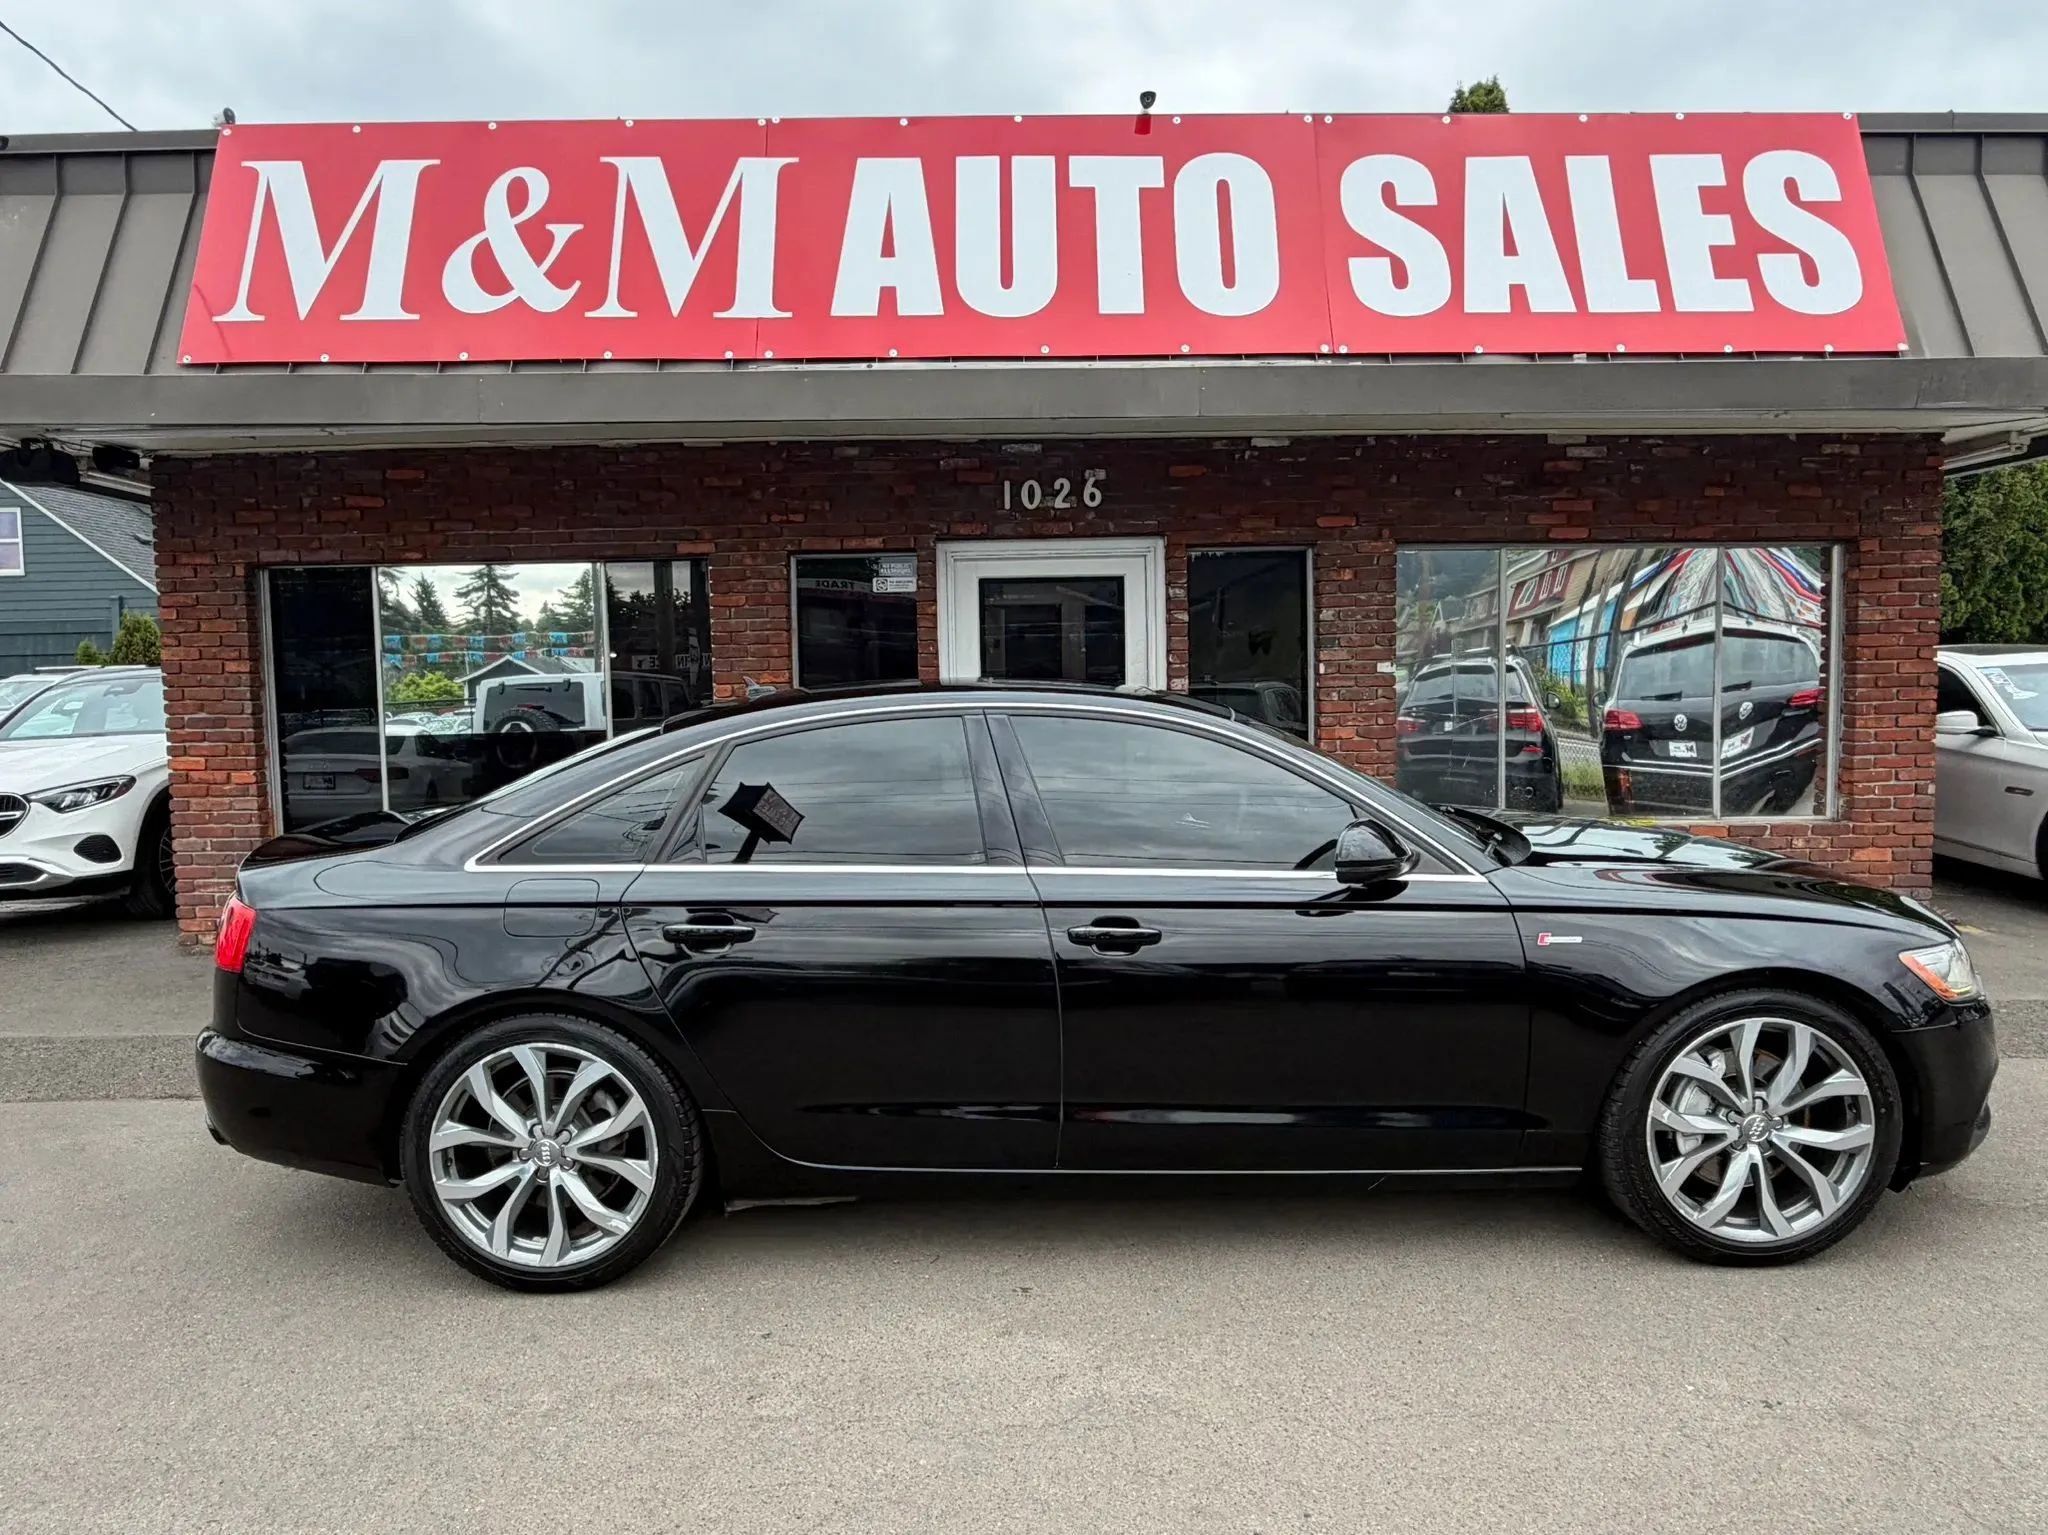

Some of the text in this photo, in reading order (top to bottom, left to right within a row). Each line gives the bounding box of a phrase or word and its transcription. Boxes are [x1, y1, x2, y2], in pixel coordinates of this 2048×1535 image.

[213, 149, 1864, 323] M&M AUTO SALES
[1003, 477, 1103, 510] 1026
